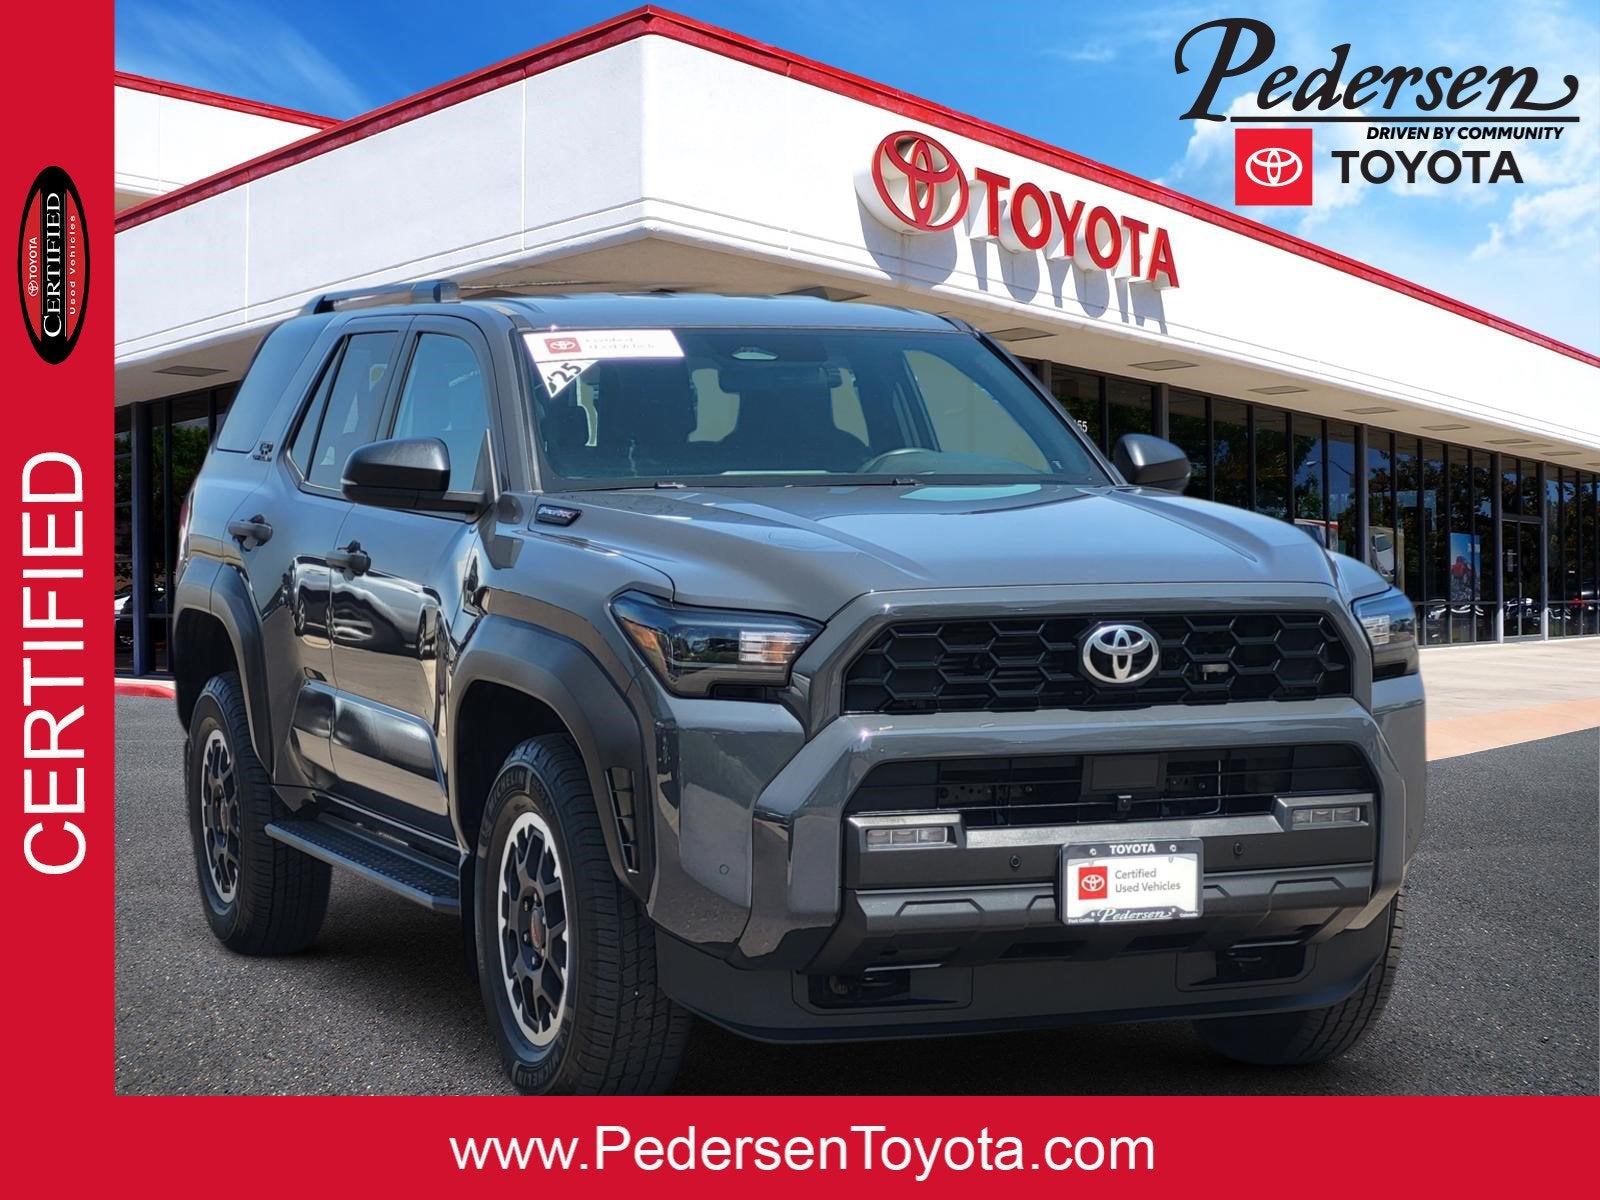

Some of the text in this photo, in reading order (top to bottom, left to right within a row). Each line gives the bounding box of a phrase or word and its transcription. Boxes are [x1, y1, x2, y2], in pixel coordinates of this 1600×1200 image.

[974, 167, 1179, 288] TOYOTA
[1109, 843, 1156, 855] TOYOTA
[1115, 868, 1157, 880] Certified
[1115, 880, 1182, 893] Used Vehicles
[1097, 908, 1173, 923] Pedersen
